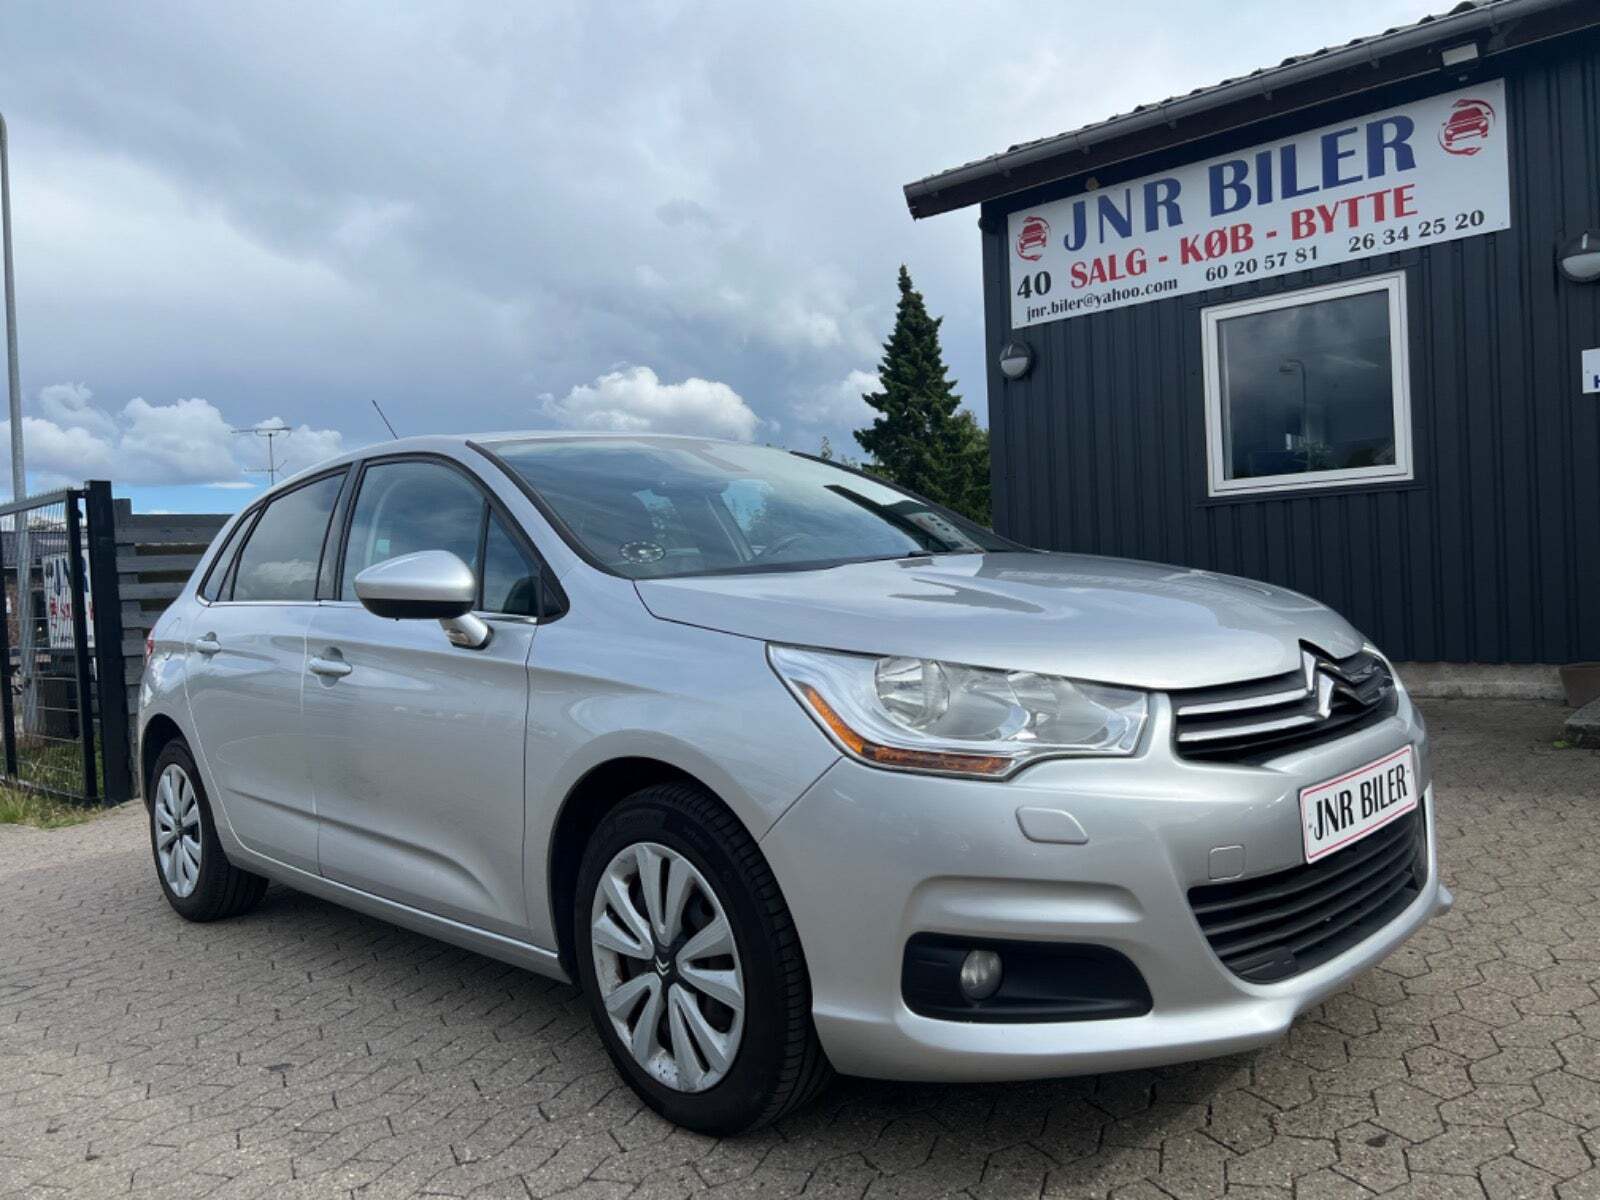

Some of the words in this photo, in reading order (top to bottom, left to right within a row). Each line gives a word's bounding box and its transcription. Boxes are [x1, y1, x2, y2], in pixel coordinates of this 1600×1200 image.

[1063, 177, 1183, 251] JNR
[1208, 115, 1416, 217] BILER
[1071, 248, 1147, 289] SALG
[1180, 223, 1254, 265] KØB
[1291, 184, 1418, 241] BYTTE
[1349, 233, 1375, 252] 26
[1383, 226, 1409, 245] 34
[1418, 217, 1446, 237] 25
[1455, 210, 1484, 230] 20
[1017, 271, 1052, 299] 40
[1206, 265, 1228, 282] 60
[1234, 259, 1258, 276] 20
[1264, 252, 1288, 270] 57
[1295, 246, 1317, 263] 81
[1026, 278, 1178, 322] jnr.biler@yahoo.com
[1314, 789, 1354, 840] JNR
[1360, 763, 1407, 819] BILER
